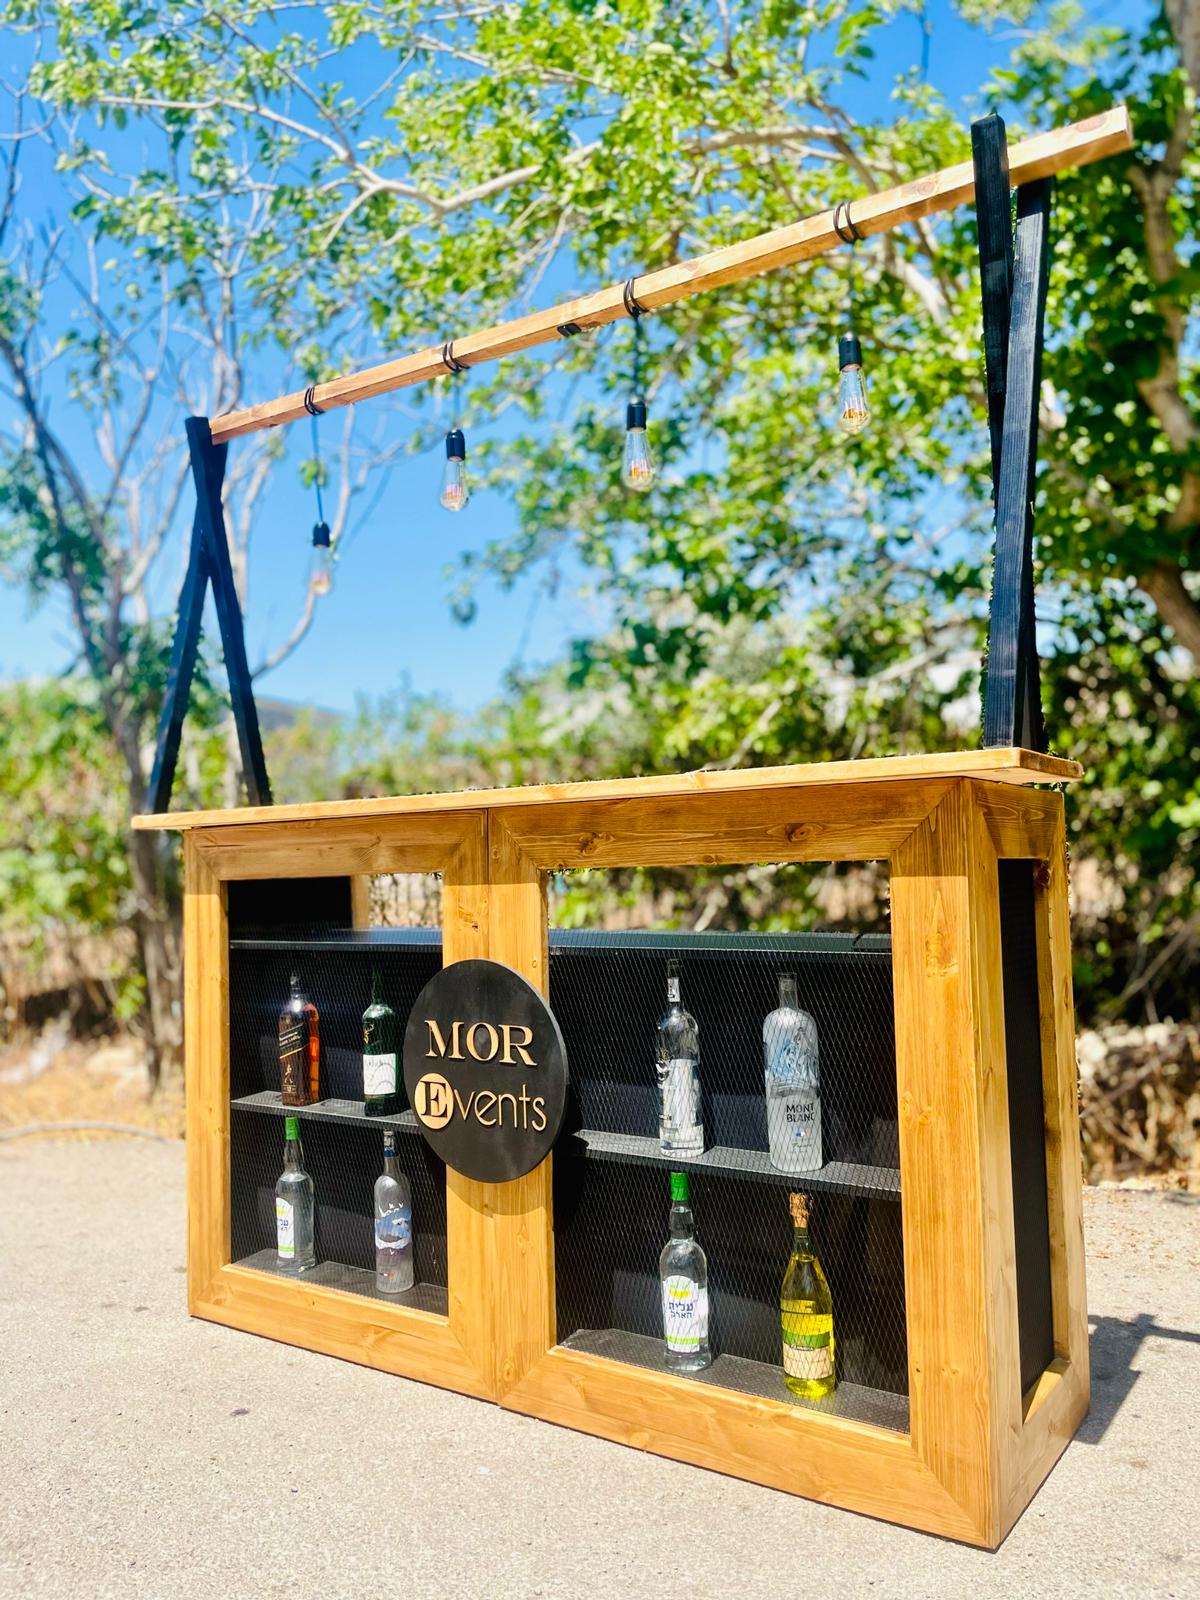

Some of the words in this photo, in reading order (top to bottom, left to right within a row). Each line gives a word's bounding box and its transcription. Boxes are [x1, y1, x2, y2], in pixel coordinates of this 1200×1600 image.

[424, 1020, 537, 1066] MOR
[416, 1075, 547, 1132] Events
[786, 1103, 814, 1113] MONT
[786, 1112, 815, 1122] BLANC
